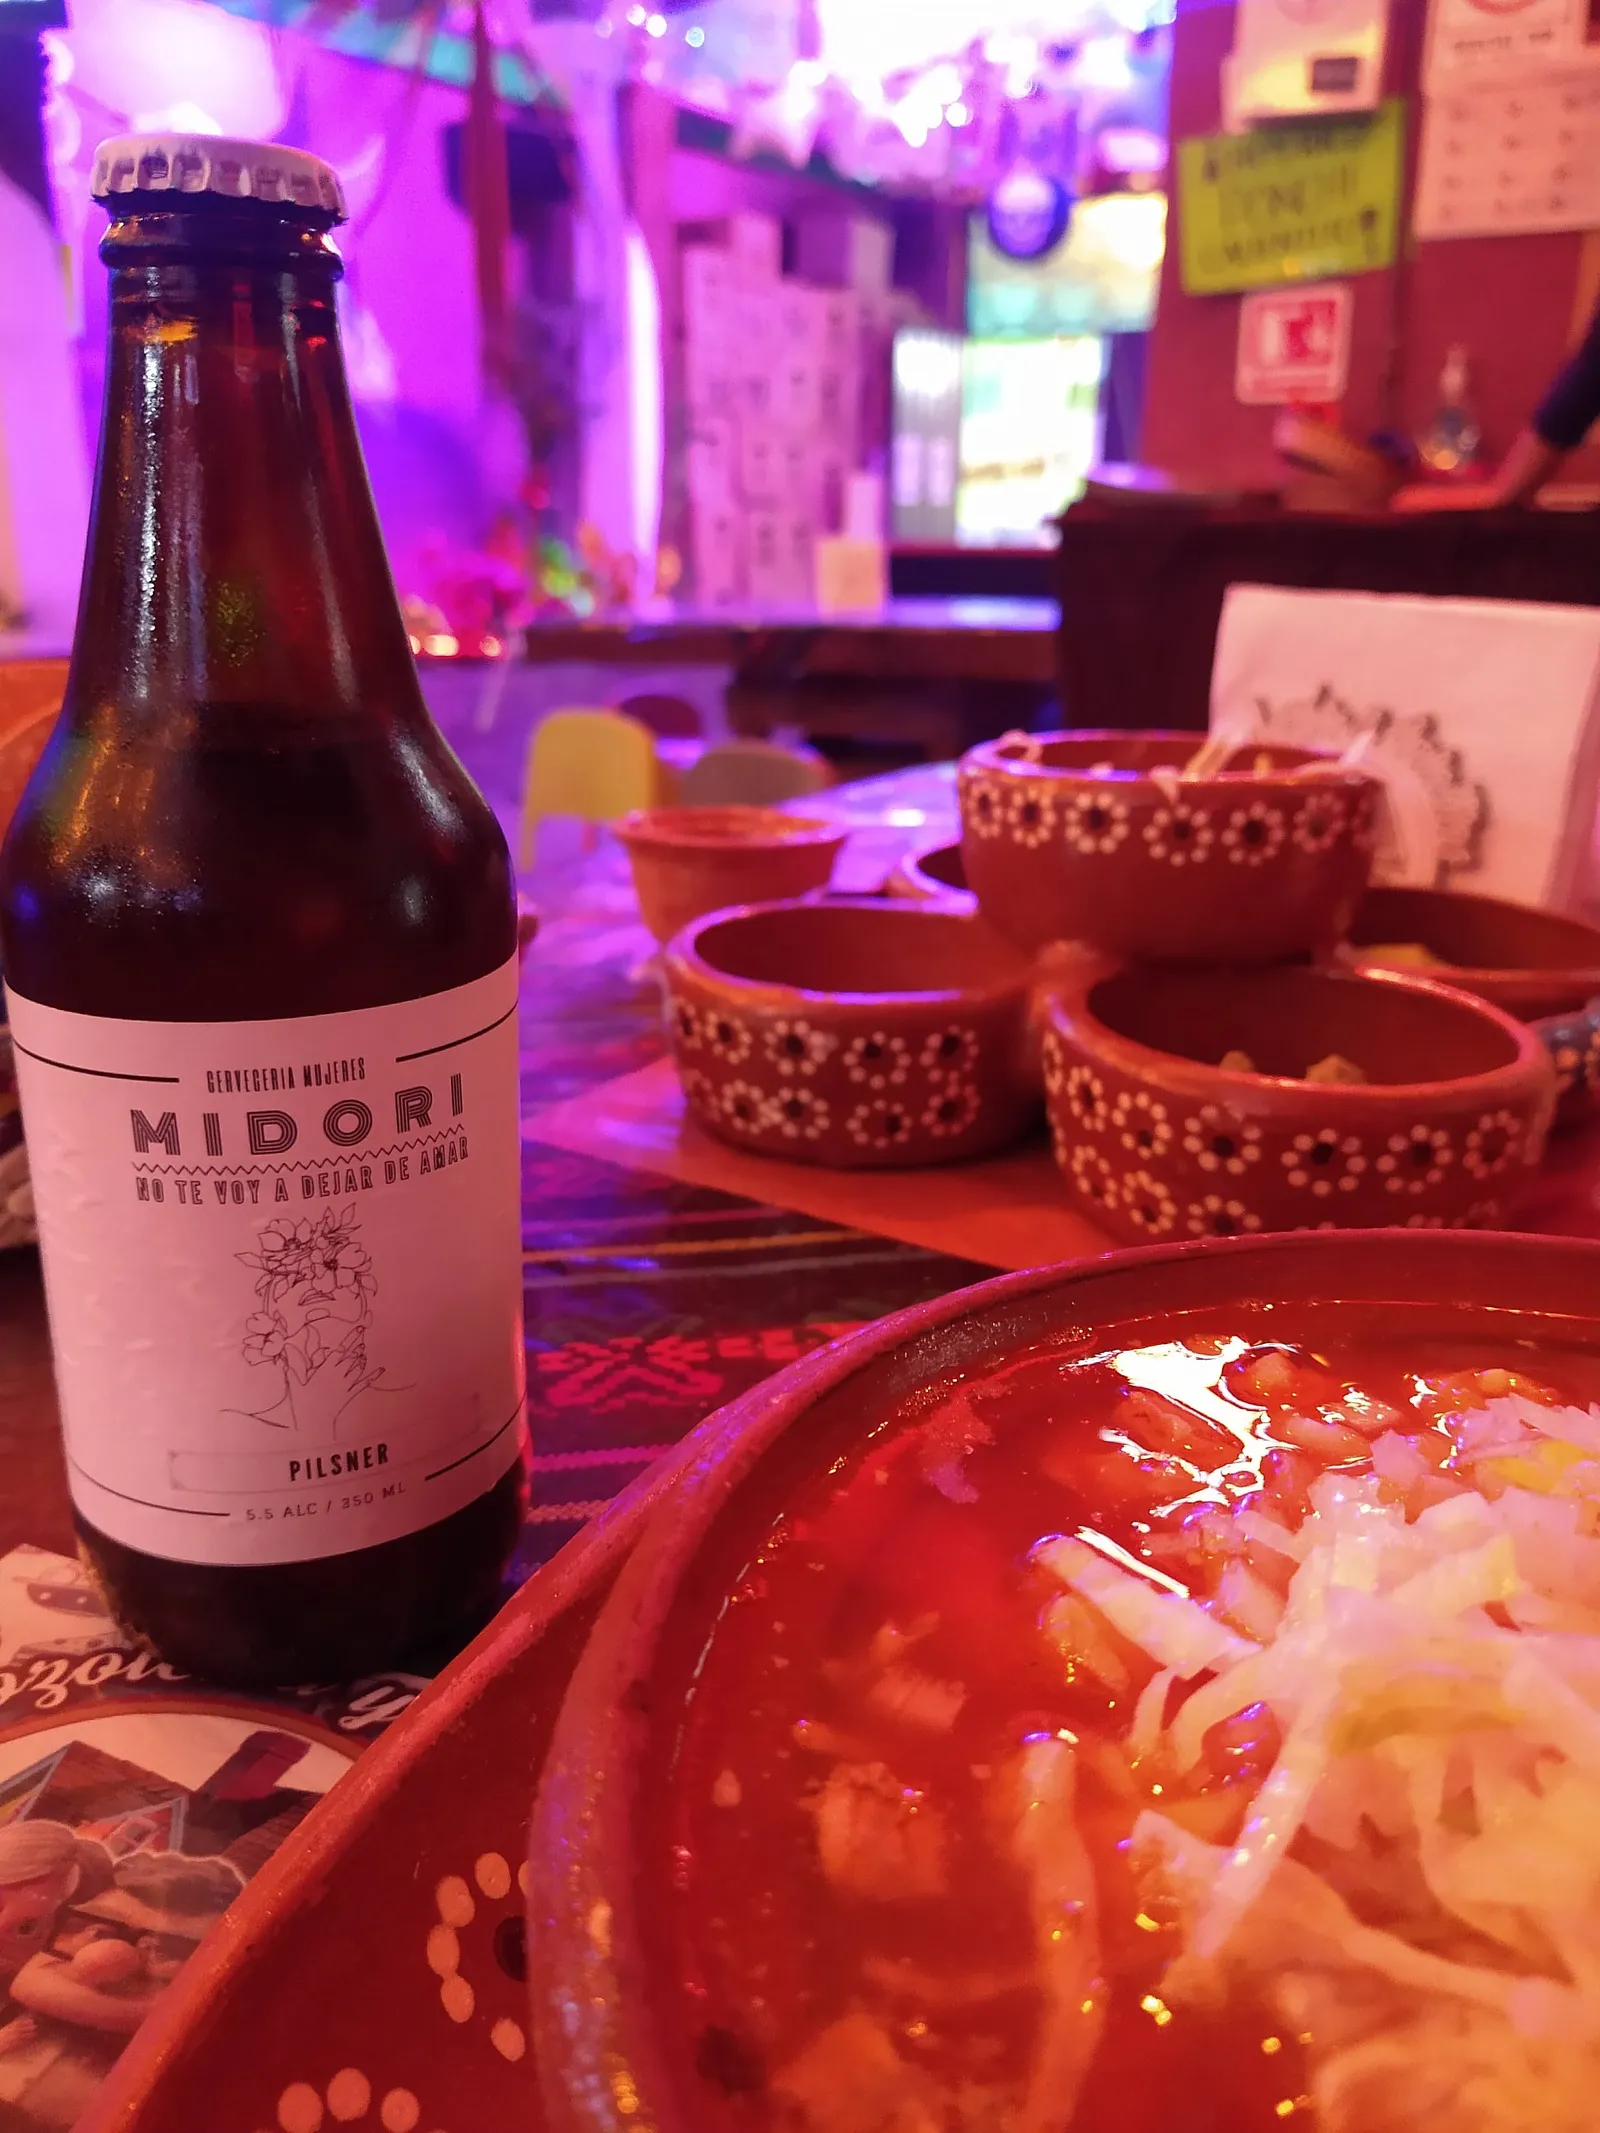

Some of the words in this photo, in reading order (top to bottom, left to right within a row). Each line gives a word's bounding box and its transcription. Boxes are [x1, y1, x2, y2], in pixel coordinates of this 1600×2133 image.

[303, 1056, 366, 1088] MUJERES
[130, 1073, 465, 1157] MIDORI
[136, 1176, 165, 1202] NO
[175, 1179, 204, 1205] TE
[214, 1179, 261, 1205] VOY
[274, 1178, 290, 1202] A
[301, 1165, 374, 1200] DEJAR
[384, 1156, 410, 1185] DE
[419, 1136, 470, 1175] AMAR
[289, 1442, 390, 1482] PILSNER
[246, 1507, 274, 1521] 5.5
[283, 1502, 318, 1519] ALC
[341, 1492, 374, 1509] 350
[381, 1481, 407, 1499] ML
